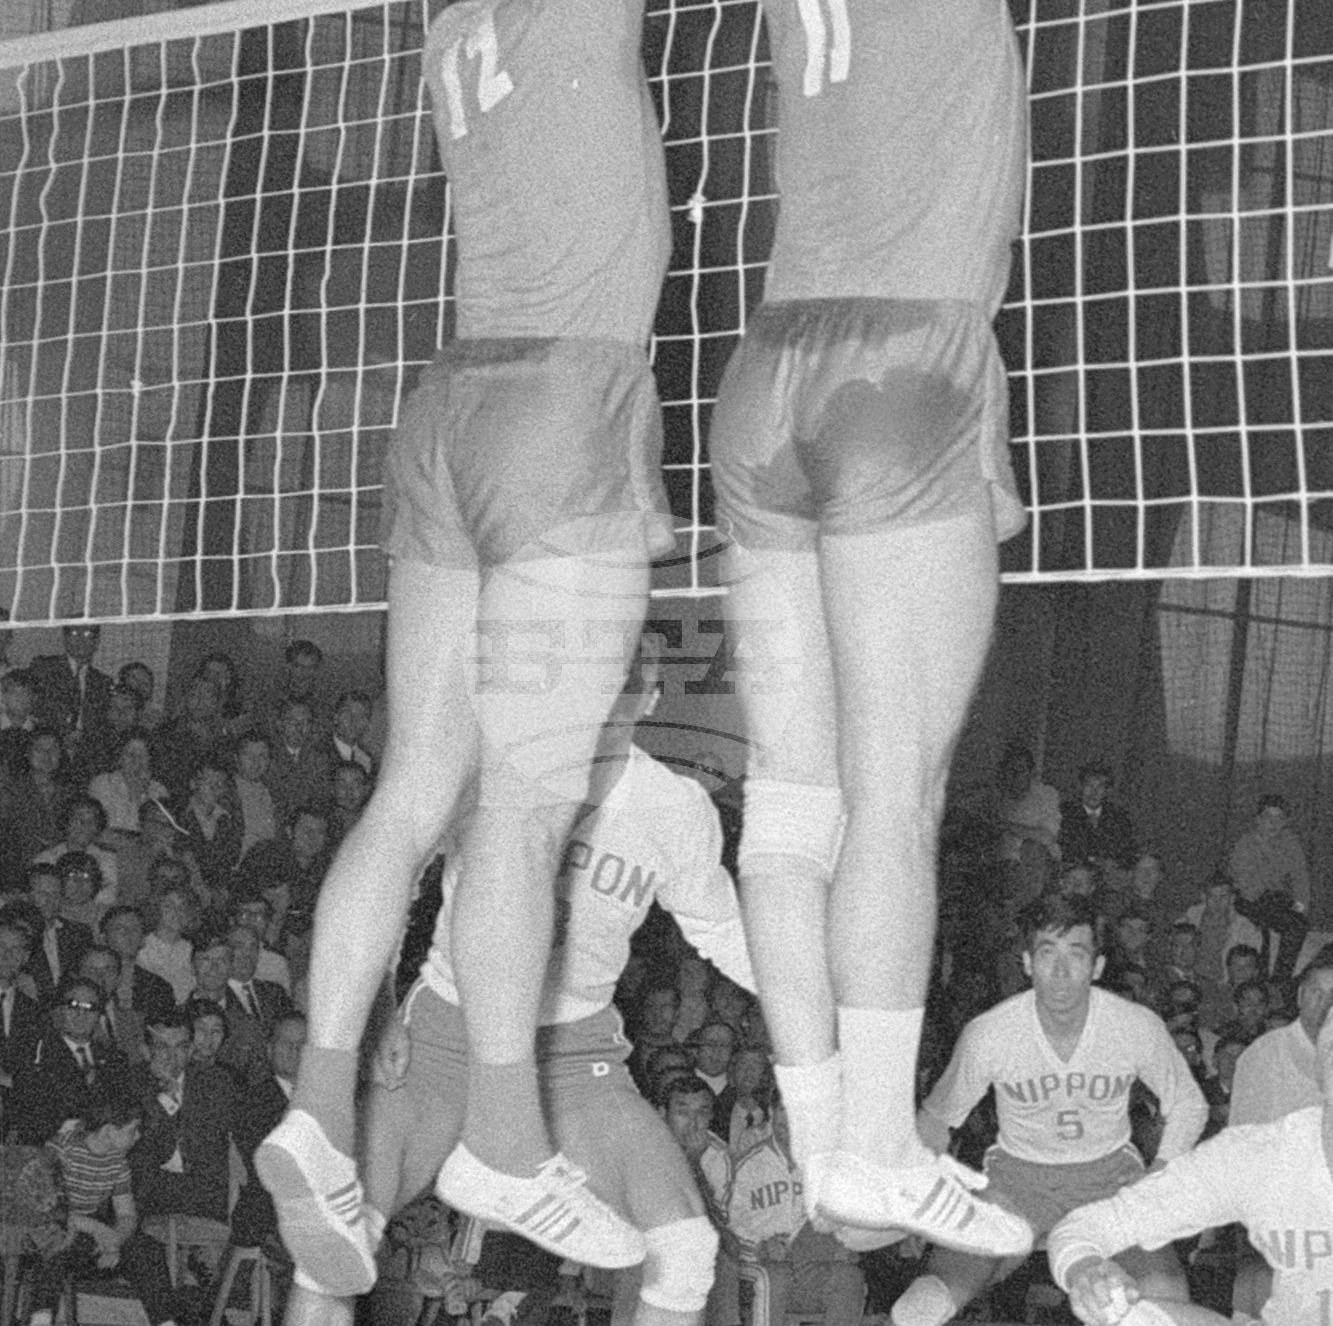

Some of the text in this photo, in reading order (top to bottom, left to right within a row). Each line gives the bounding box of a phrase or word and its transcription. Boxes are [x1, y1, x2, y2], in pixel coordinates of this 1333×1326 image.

[441, 11, 515, 140] 12
[1003, 1071, 1132, 1103] NIPPON
[1056, 1109, 1085, 1141] 5
[749, 1180, 804, 1211] NIPP
